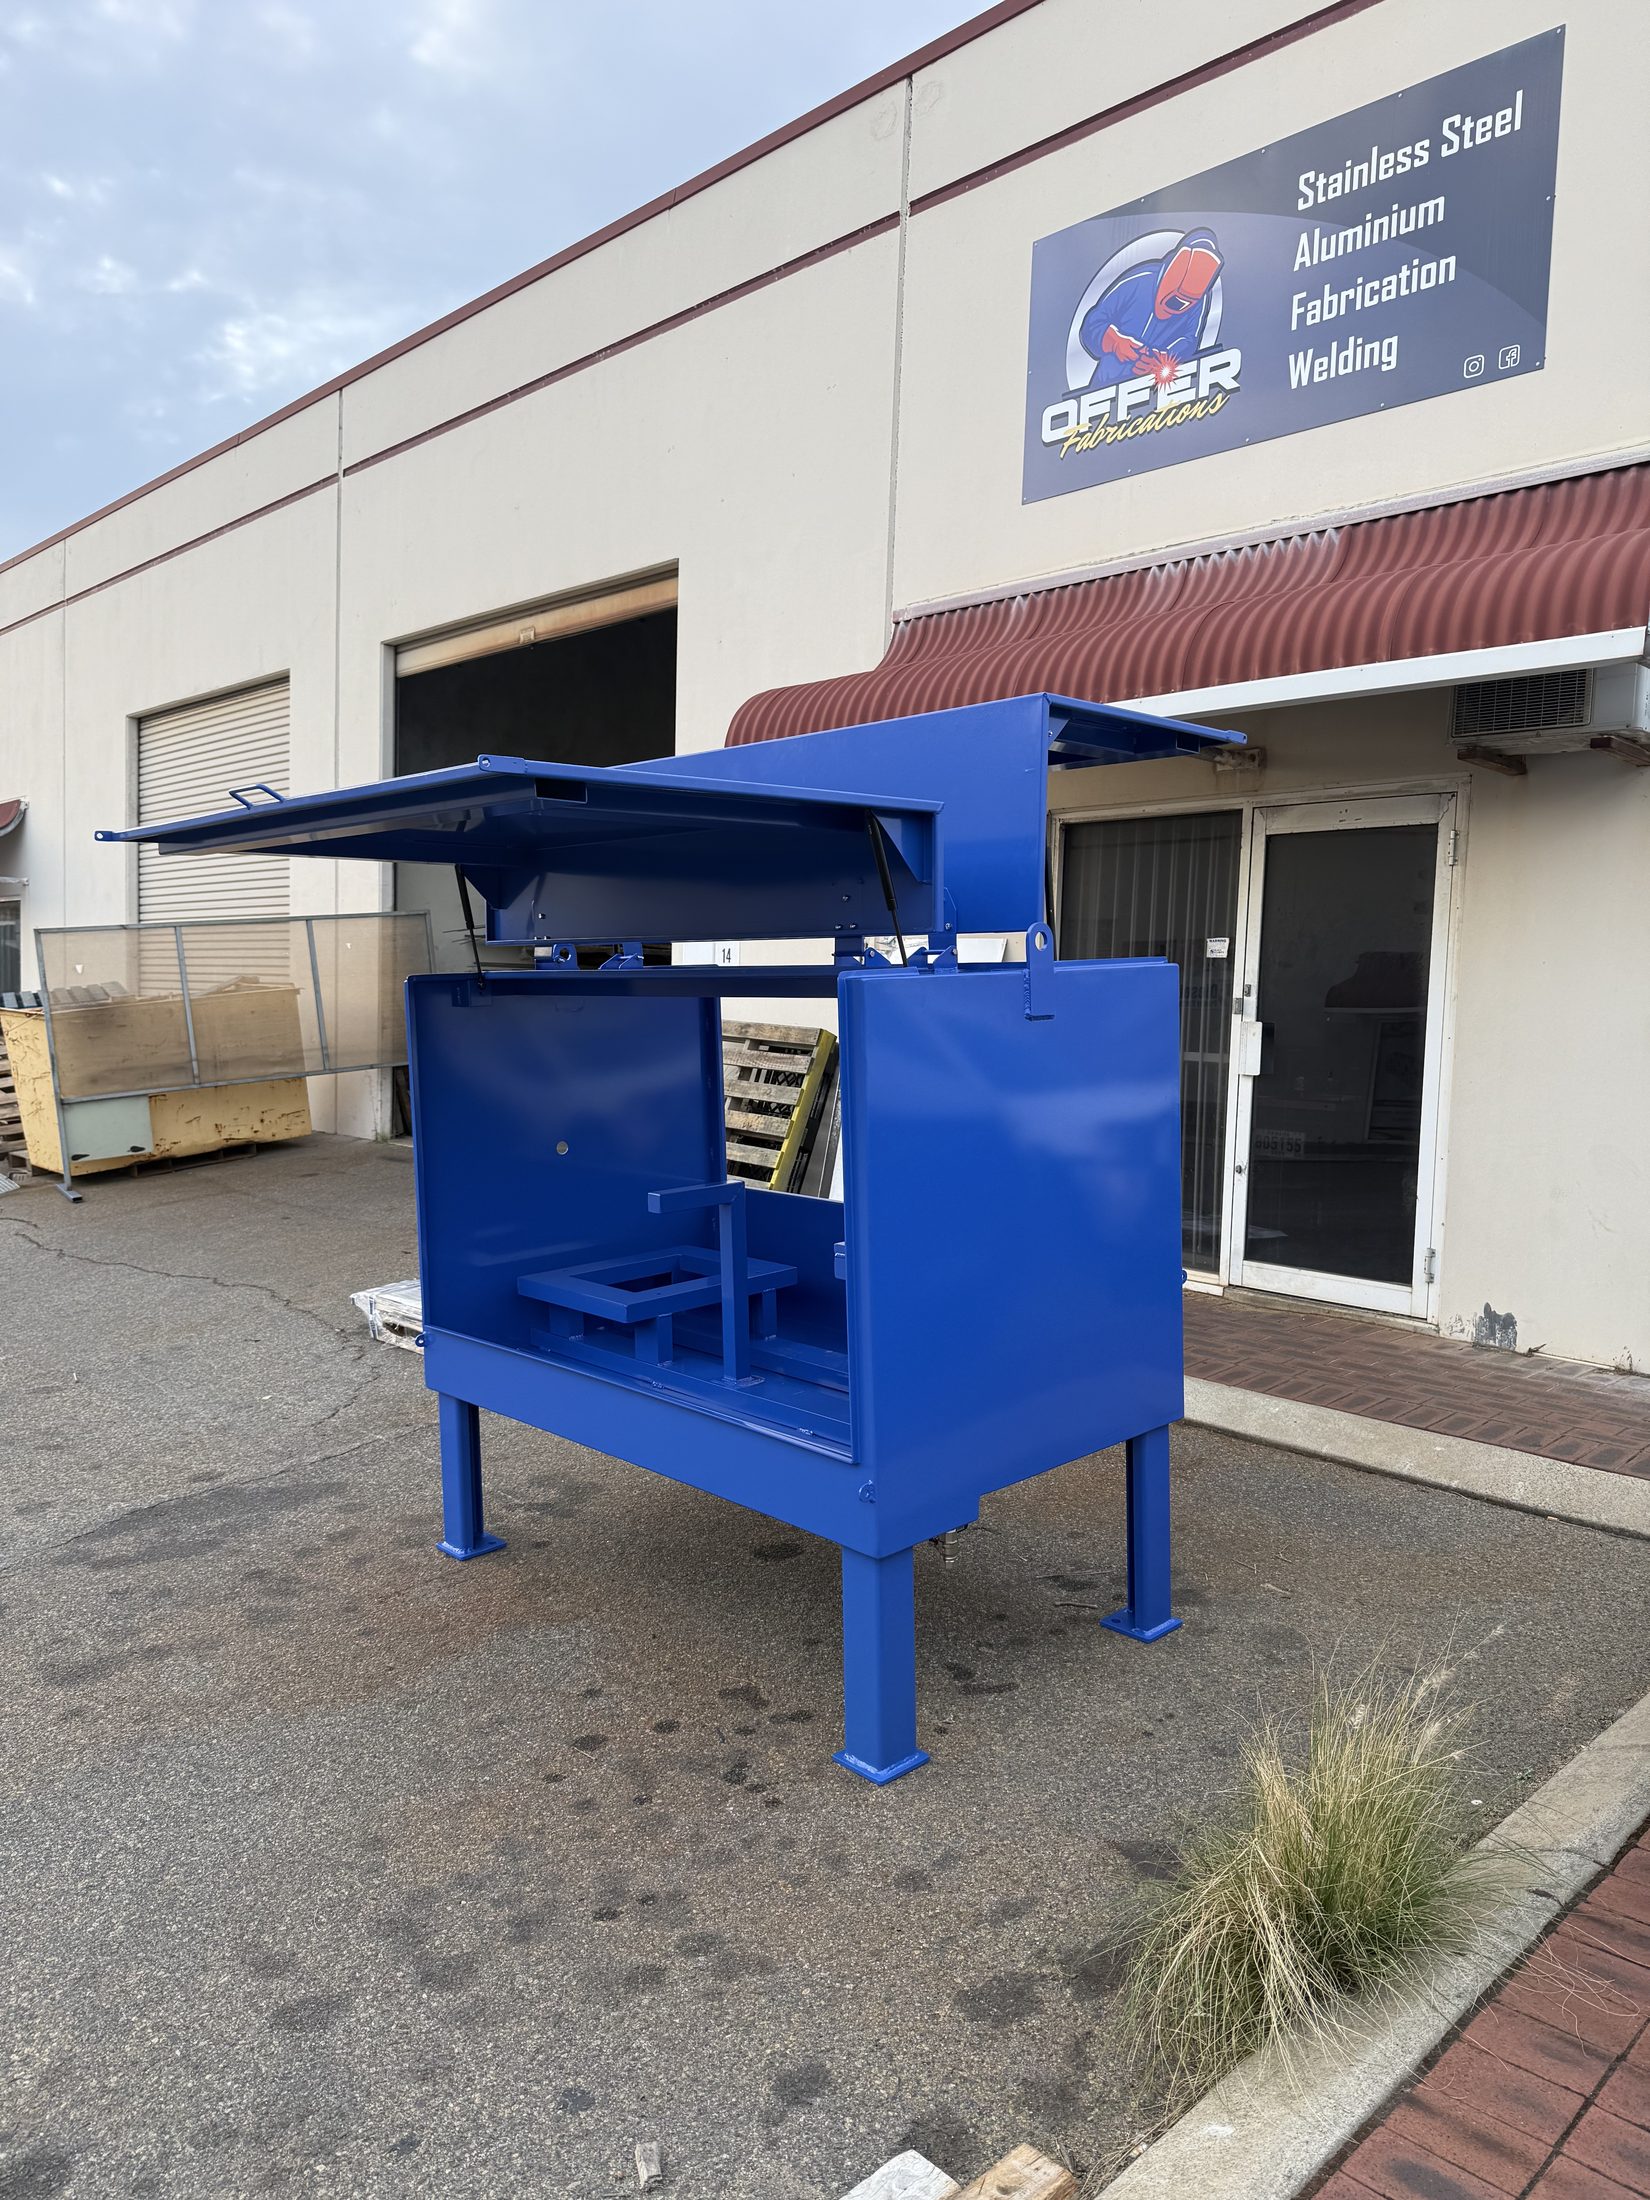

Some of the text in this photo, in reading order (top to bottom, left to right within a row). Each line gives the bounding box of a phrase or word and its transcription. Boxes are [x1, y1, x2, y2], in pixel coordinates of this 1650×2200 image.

[1297, 89, 1524, 211] Stainless Steel
[1293, 196, 1446, 272] Aluminium
[1291, 255, 1457, 331] Fabrication
[1041, 348, 1242, 445] OFFER
[1288, 335, 1399, 390] Welding
[1059, 392, 1231, 459] Fabrications
[722, 947, 732, 964] 14
